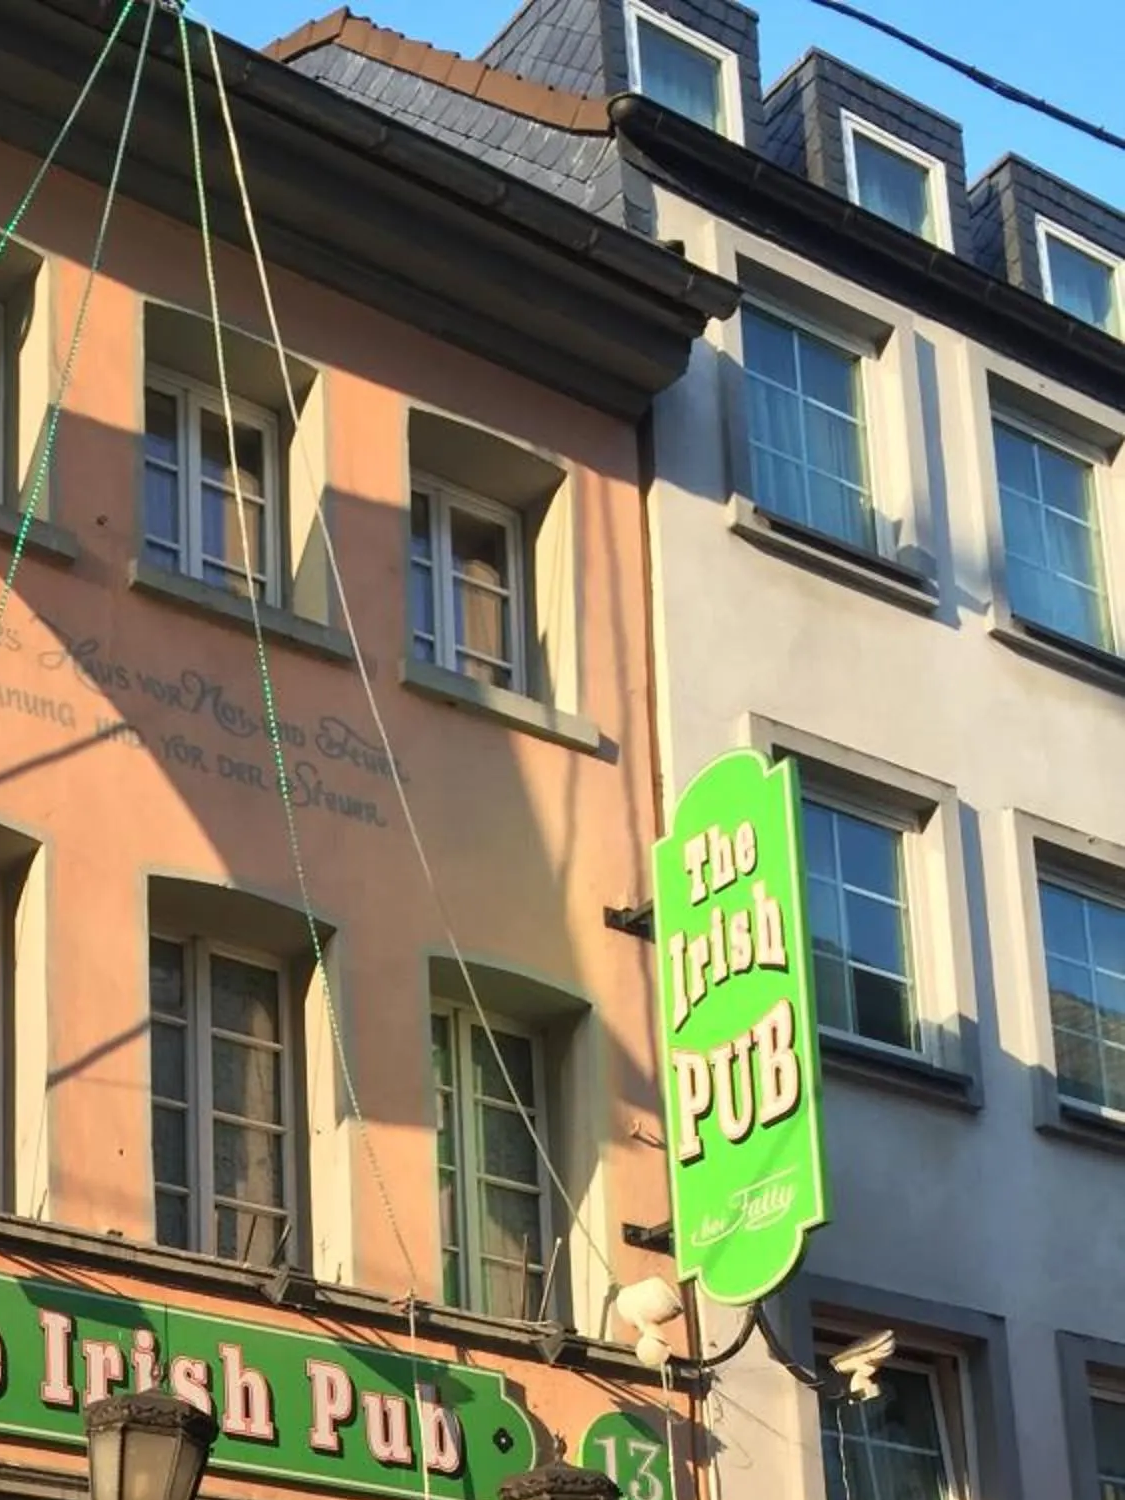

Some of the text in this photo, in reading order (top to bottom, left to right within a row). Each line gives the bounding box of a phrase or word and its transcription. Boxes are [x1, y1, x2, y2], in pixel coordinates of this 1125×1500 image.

[683, 820, 757, 904] The
[668, 880, 787, 1032] Irish
[672, 998, 802, 1163] PUB
[39, 1308, 275, 1441] Irish
[307, 1359, 464, 1475] Pub
